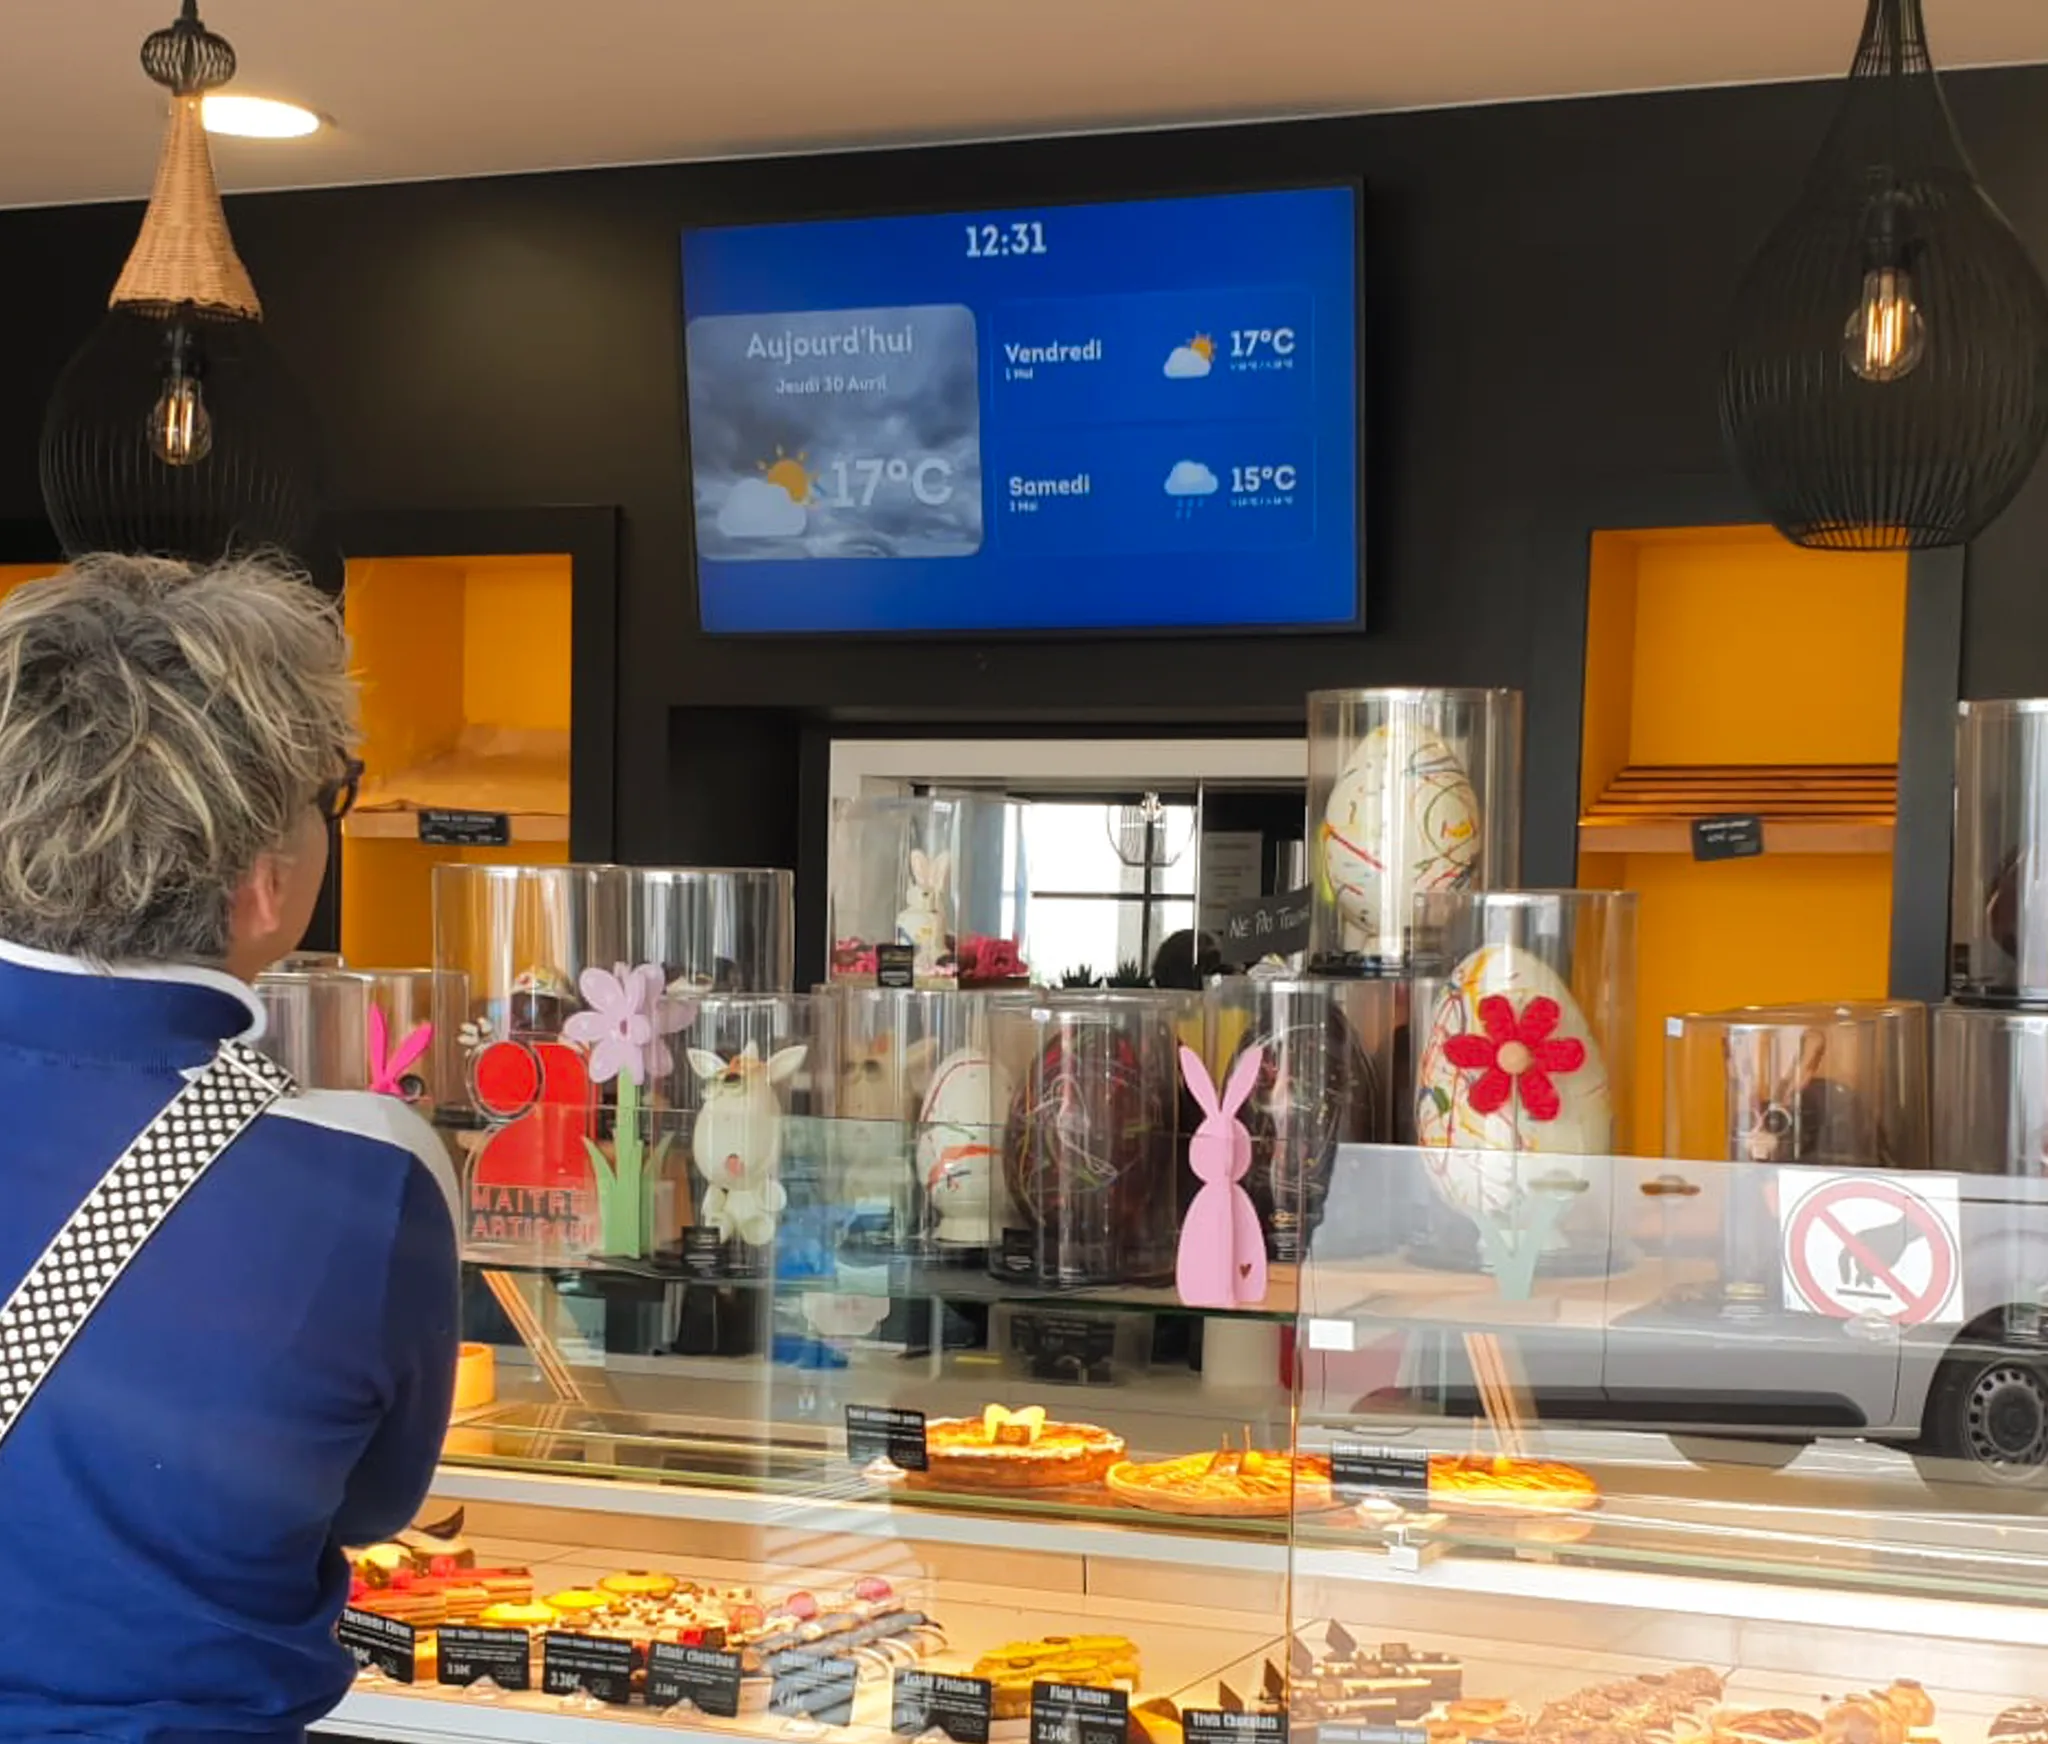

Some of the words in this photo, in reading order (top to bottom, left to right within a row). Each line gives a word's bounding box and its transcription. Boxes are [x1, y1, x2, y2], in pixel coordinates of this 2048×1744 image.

[966, 222, 1047, 258] 12:31
[746, 325, 914, 364] Aujourd'hui
[1004, 338, 1103, 365] Vendredi
[1230, 327, 1296, 357] 17°C
[776, 376, 820, 395] Jeudi
[848, 374, 887, 392] Avril
[830, 456, 954, 509] 17°C
[1008, 473, 1091, 497] Samedi
[1231, 465, 1297, 493] 15°C
